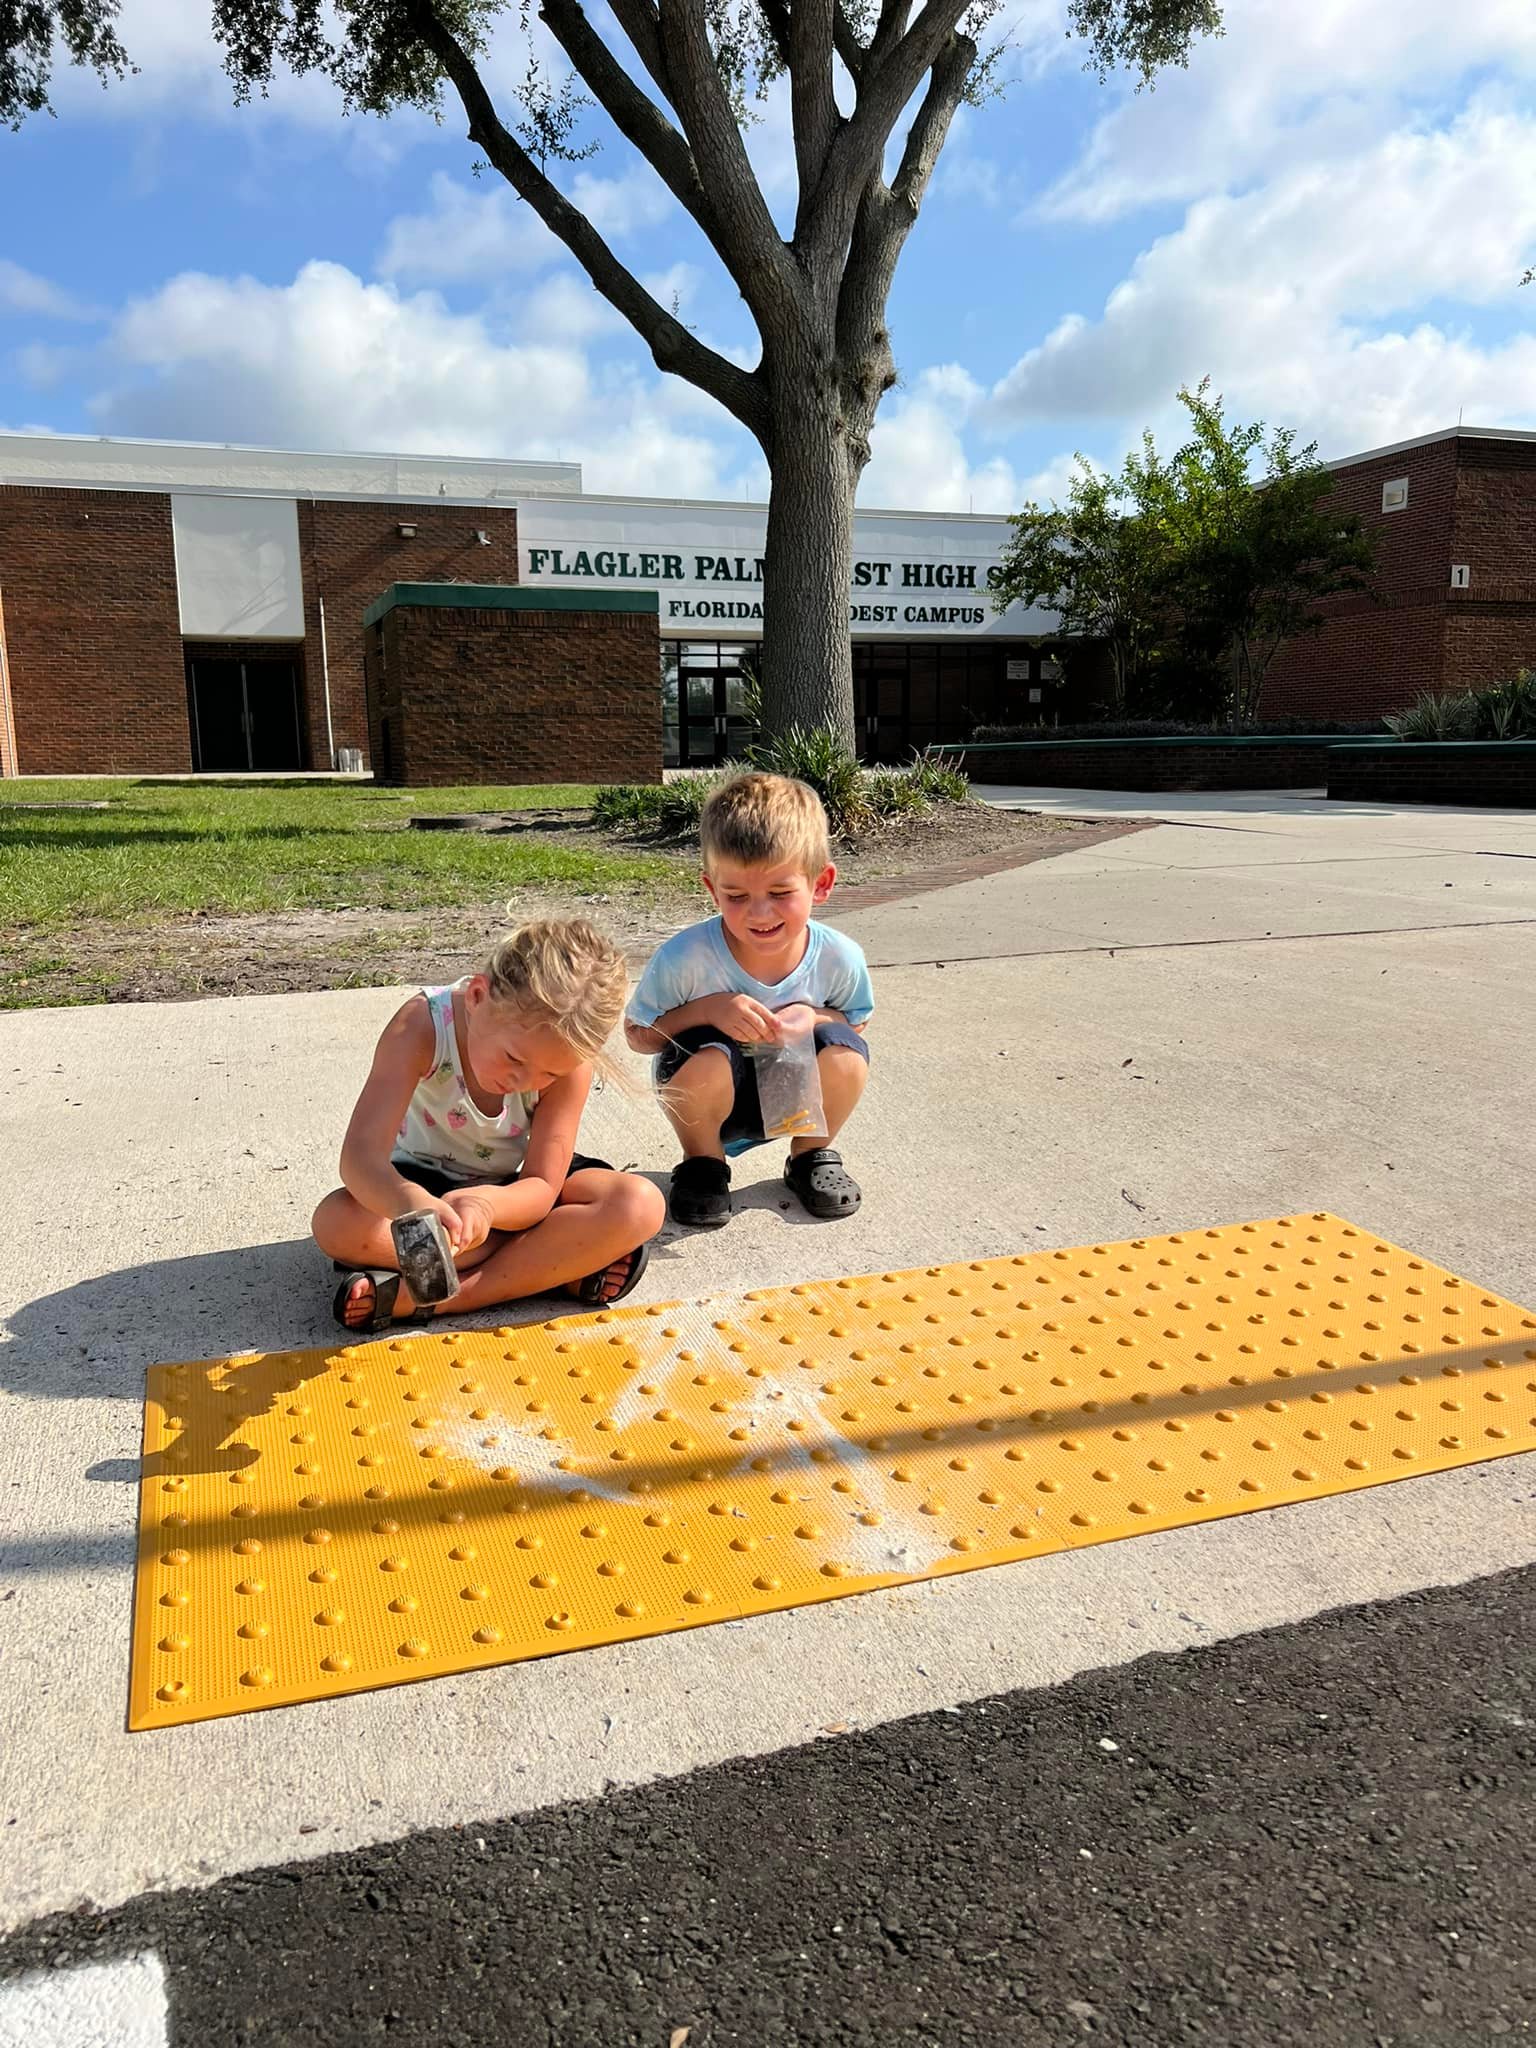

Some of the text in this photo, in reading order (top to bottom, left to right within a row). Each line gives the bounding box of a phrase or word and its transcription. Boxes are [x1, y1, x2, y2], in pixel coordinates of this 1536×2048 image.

[528, 549, 685, 579] FLAGLER
[902, 564, 976, 588] HIGH
[1457, 567, 1464, 585] 1
[669, 601, 984, 624] FLORIDA DEST CAMPUS
